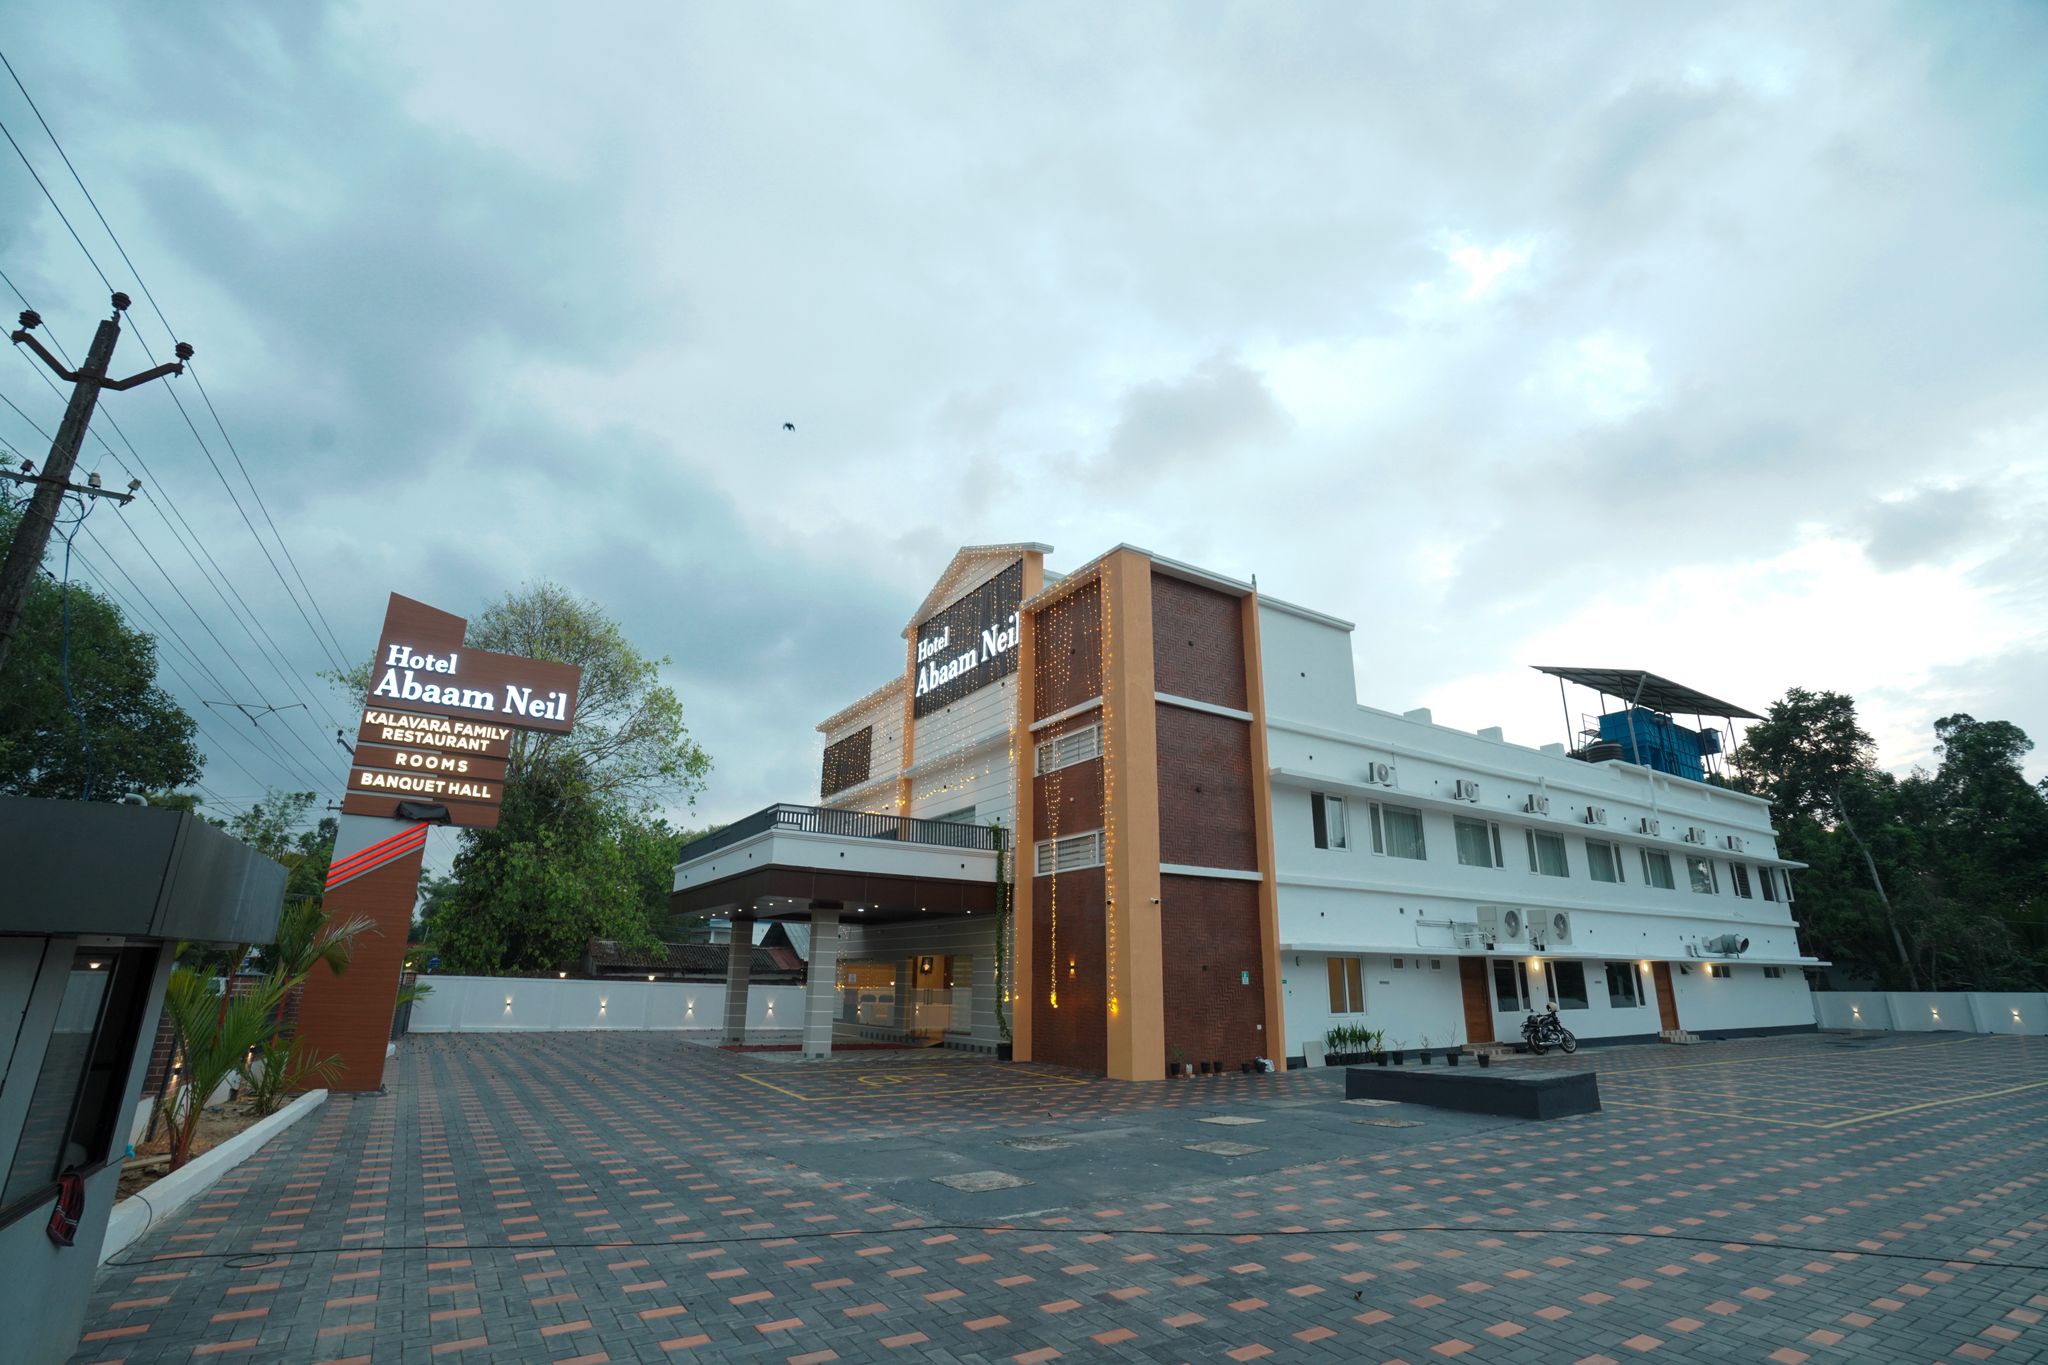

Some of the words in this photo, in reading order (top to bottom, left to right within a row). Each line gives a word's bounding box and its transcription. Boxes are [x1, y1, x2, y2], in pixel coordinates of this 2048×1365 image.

[916, 649, 978, 698] Abaam
[981, 611, 1019, 662] Neil
[917, 625, 950, 663] Hotel
[386, 644, 458, 674] Hotel
[374, 668, 494, 711] Abaam
[502, 685, 567, 721] Neil
[366, 712, 451, 733] KALAVARA
[454, 723, 509, 741] FAMILY
[382, 728, 490, 752] RESTAURANT
[395, 753, 469, 773] ROOMS
[361, 773, 446, 793] BANQUET
[448, 782, 491, 799] HALL
